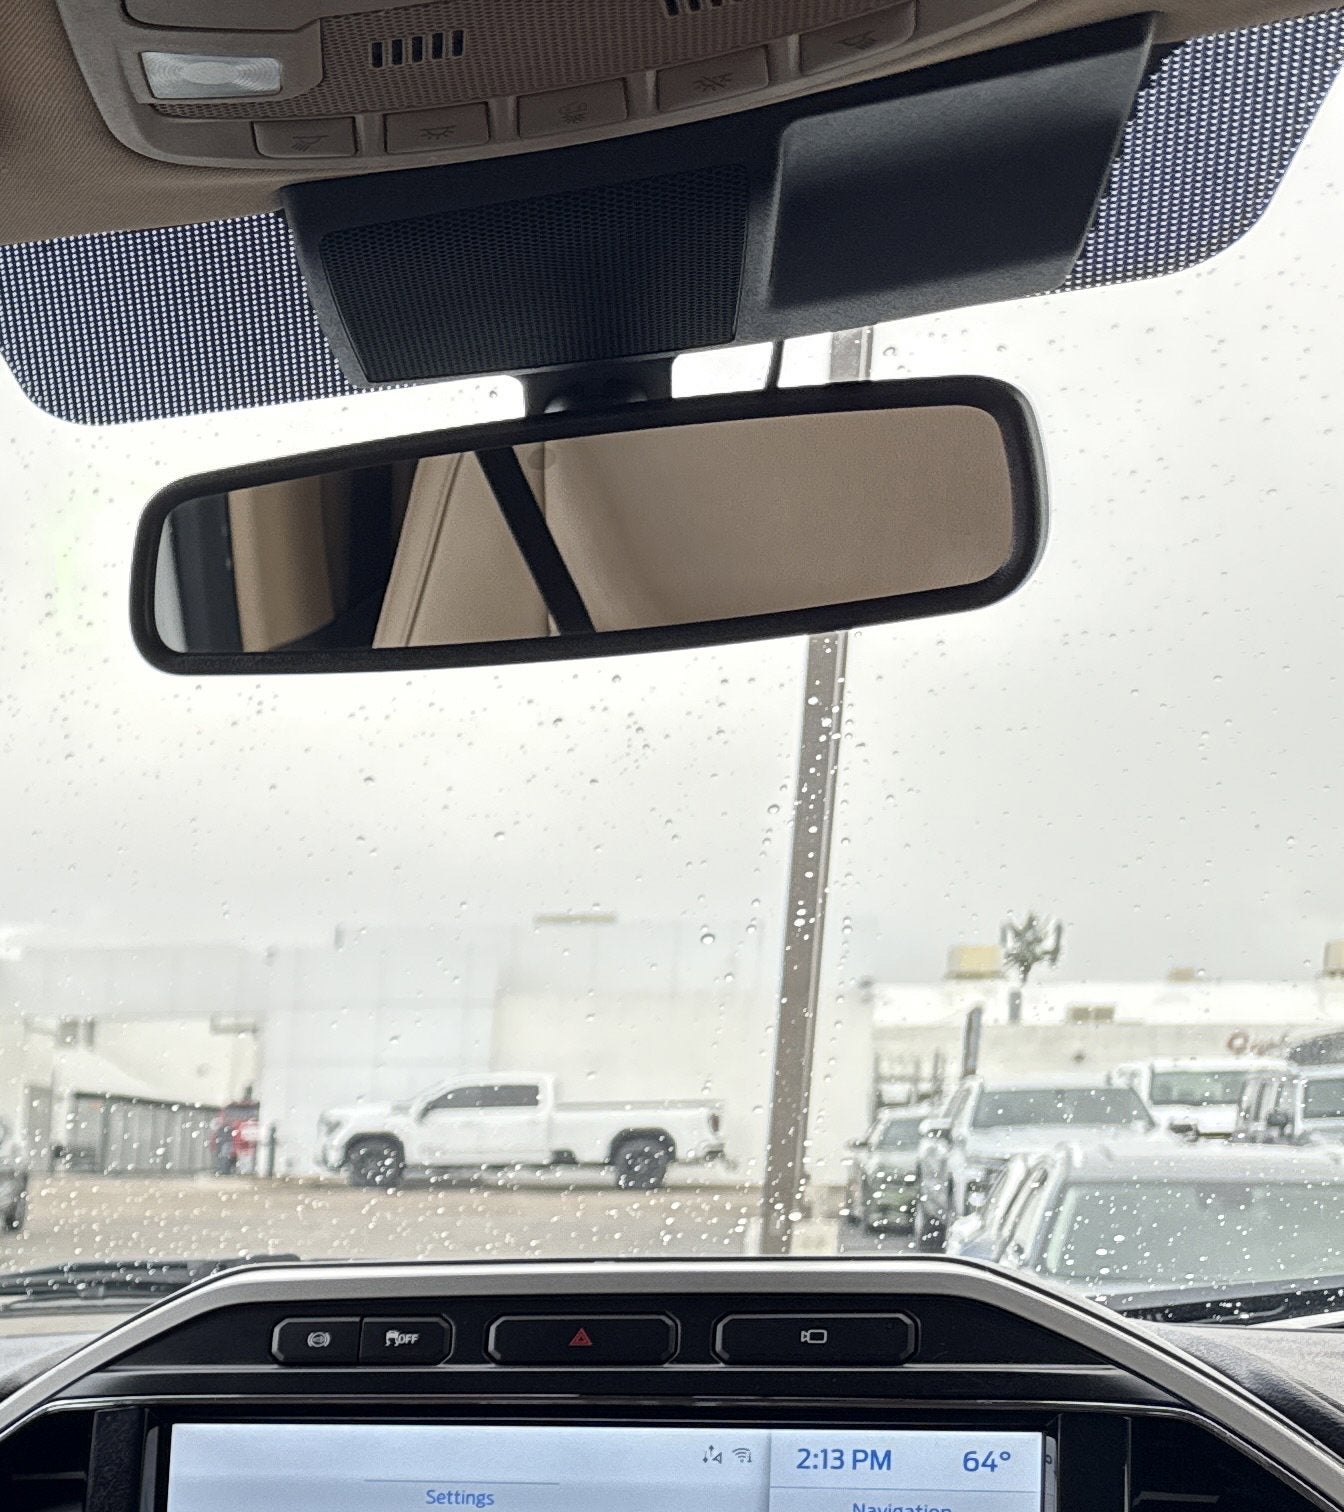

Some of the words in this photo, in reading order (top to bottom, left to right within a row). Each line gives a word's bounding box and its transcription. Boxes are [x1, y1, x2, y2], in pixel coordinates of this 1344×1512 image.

[398, 1333, 419, 1345] OFF
[796, 1448, 845, 1471] 2:13
[852, 1449, 892, 1471] PM
[963, 1450, 1011, 1473] 64°
[425, 1489, 495, 1509] Settings
